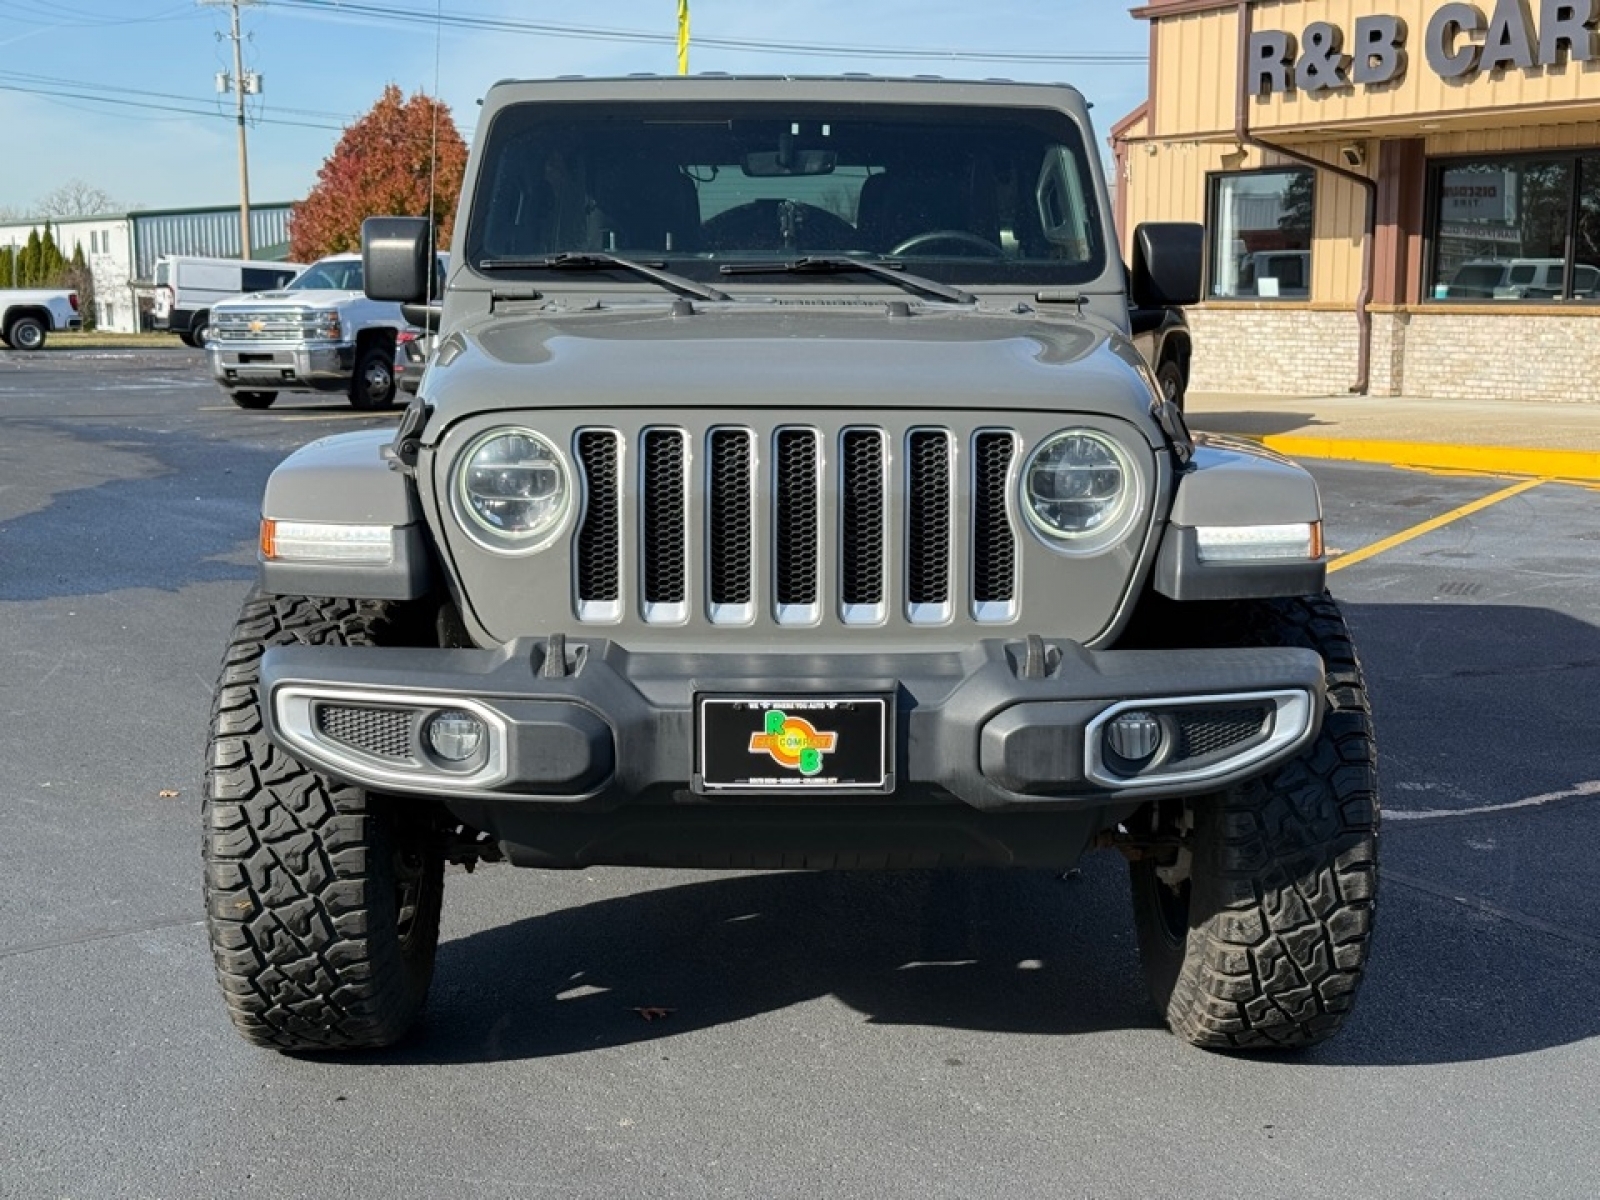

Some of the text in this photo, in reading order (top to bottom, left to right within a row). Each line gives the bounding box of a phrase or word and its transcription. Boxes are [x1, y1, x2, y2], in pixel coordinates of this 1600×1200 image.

[1248, 0, 1592, 95] R&B CAR
[765, 710, 786, 735] R
